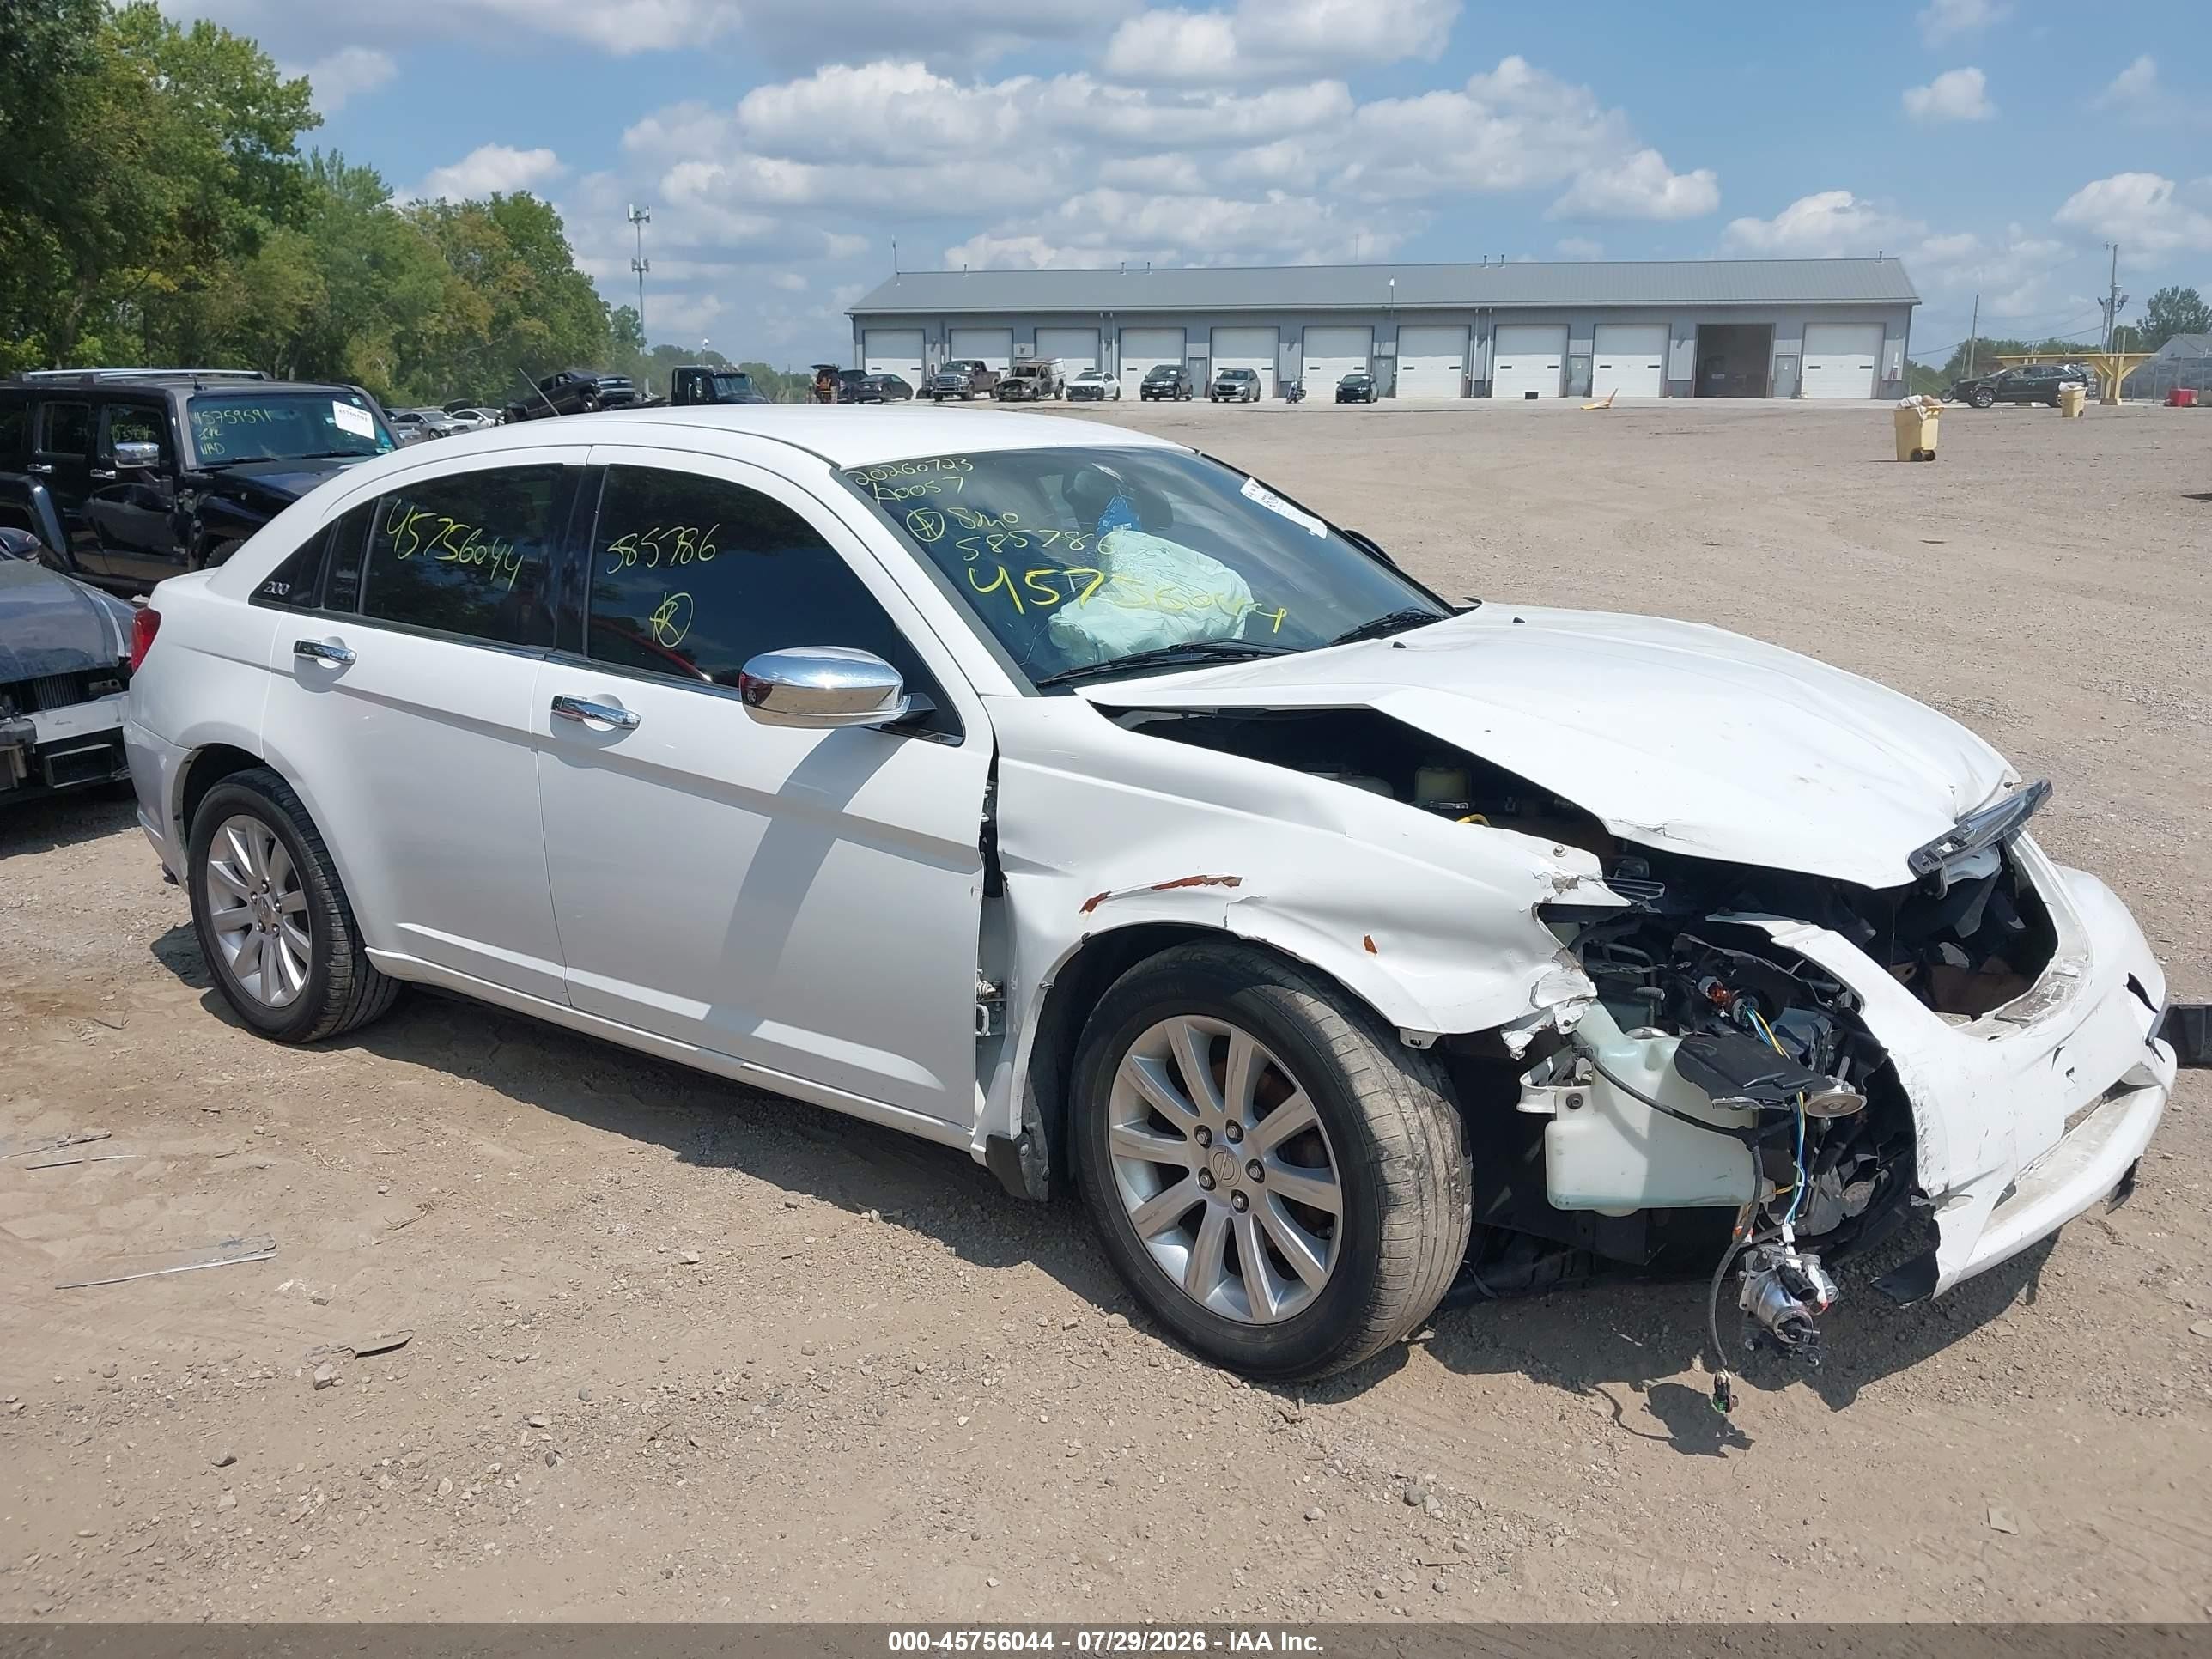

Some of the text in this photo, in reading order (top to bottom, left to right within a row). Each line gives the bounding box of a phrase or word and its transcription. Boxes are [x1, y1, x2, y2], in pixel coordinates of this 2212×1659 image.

[844, 458, 974, 486] 20260723
[386, 498, 525, 592] 45756044
[606, 523, 720, 574] 585786
[956, 529, 1119, 562] 585786
[263, 580, 291, 596] 200
[969, 565, 1288, 634] 45756044
